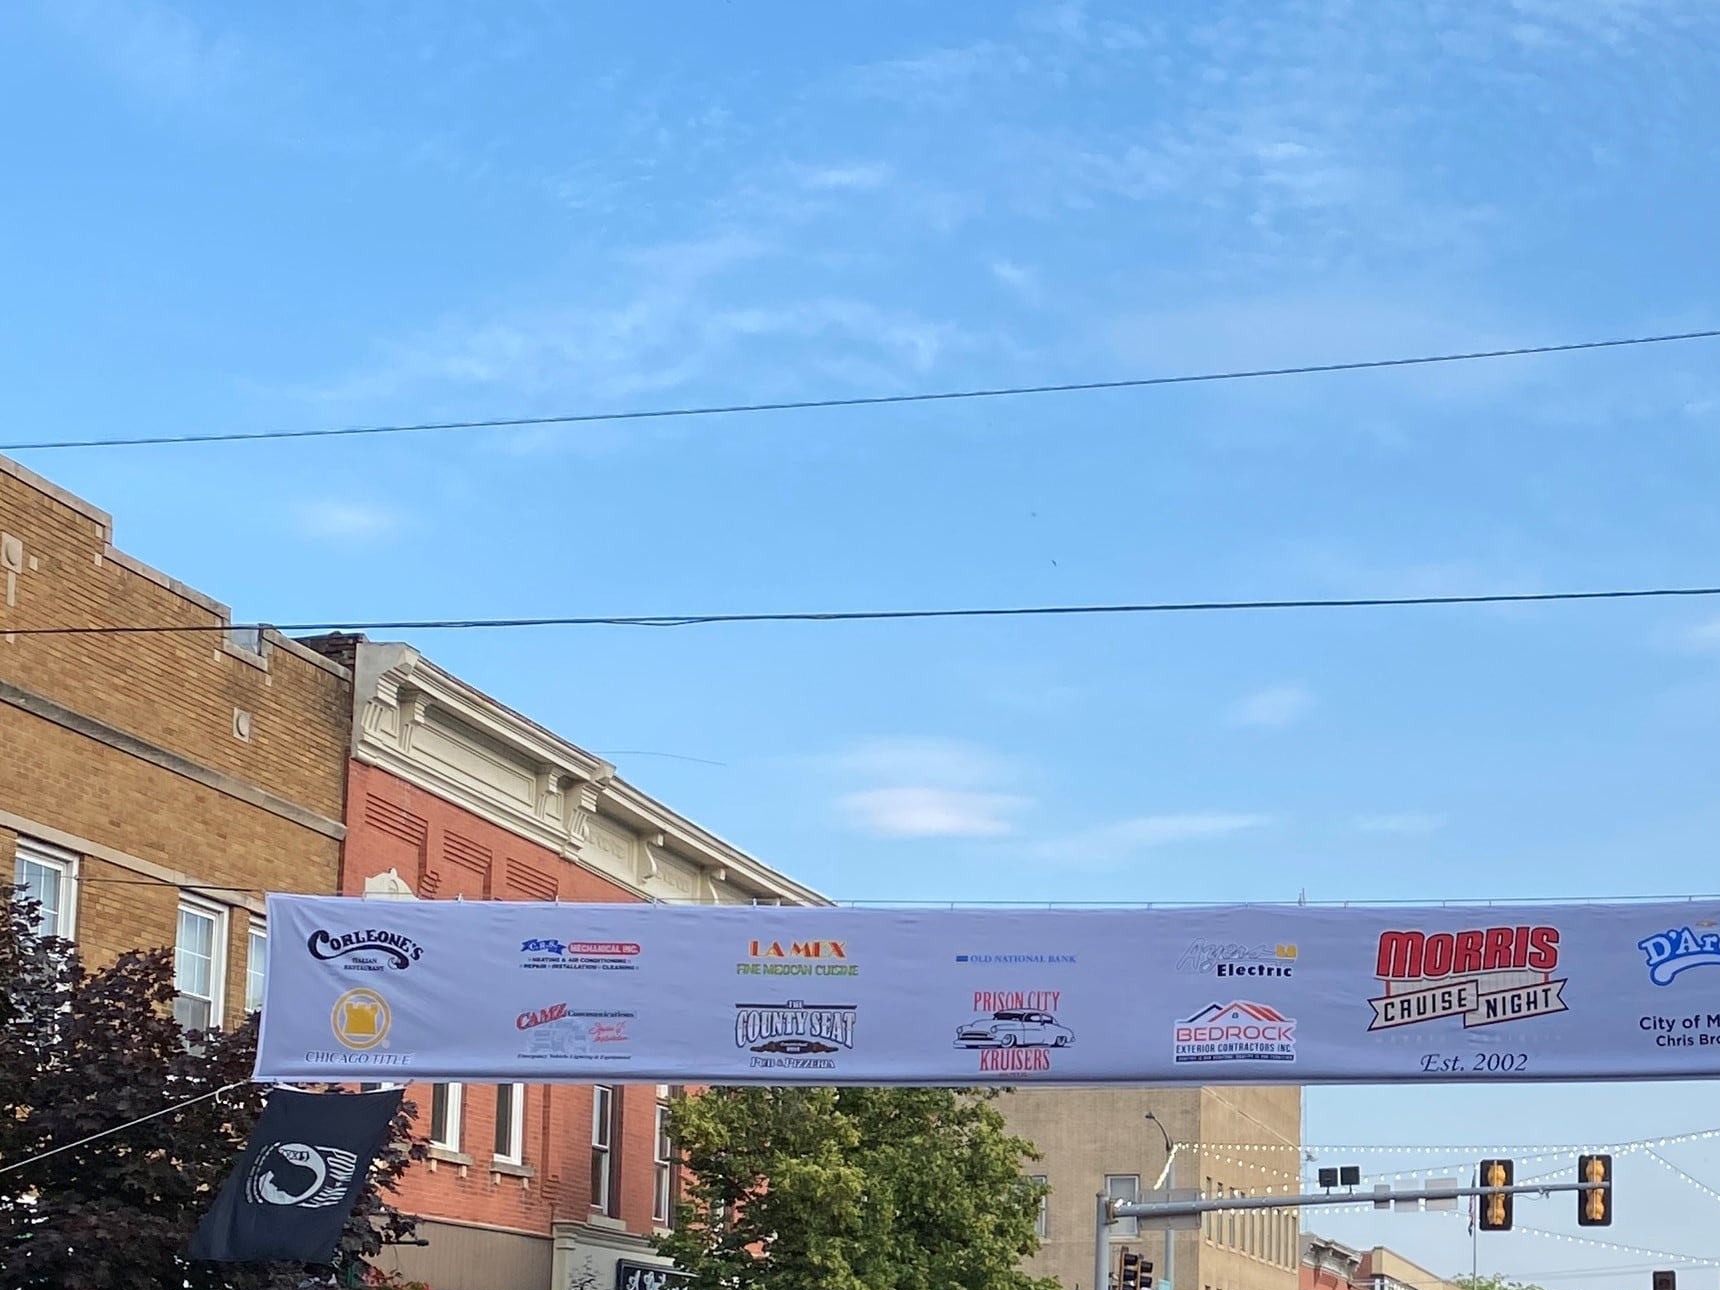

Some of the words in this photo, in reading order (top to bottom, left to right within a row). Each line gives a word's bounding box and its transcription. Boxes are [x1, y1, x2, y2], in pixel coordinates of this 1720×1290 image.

[307, 929, 424, 963] CORLEONE'S
[570, 944, 621, 953] MECHANICAL
[749, 940, 785, 957] LA
[790, 940, 846, 958] MEX
[1376, 926, 1560, 978] MORRIS
[970, 955, 992, 963] OLD
[995, 955, 1045, 963] NATIONAL
[1048, 955, 1076, 963] BANK
[1217, 964, 1292, 977] Electric
[973, 991, 1024, 1012] PRISON
[1027, 991, 1061, 1011] CITY
[1384, 988, 1467, 1022] CRUISE
[1486, 988, 1551, 1019] NIGHT
[735, 1009, 807, 1048] COUNTY
[810, 1010, 857, 1049] SEAT
[1639, 1016, 1676, 1032] City
[1682, 1015, 1700, 1029] of
[1176, 1026, 1294, 1041] BEDROCK
[1656, 1034, 1694, 1047] Chris
[305, 1051, 369, 1063] CHICAGO
[1176, 1043, 1215, 1054] EXTERIOR
[1218, 1043, 1275, 1053] CONTRACTORS
[979, 1049, 1051, 1071] KRUISERS
[1420, 1053, 1465, 1072] Est.
[1472, 1053, 1528, 1072] 2002
